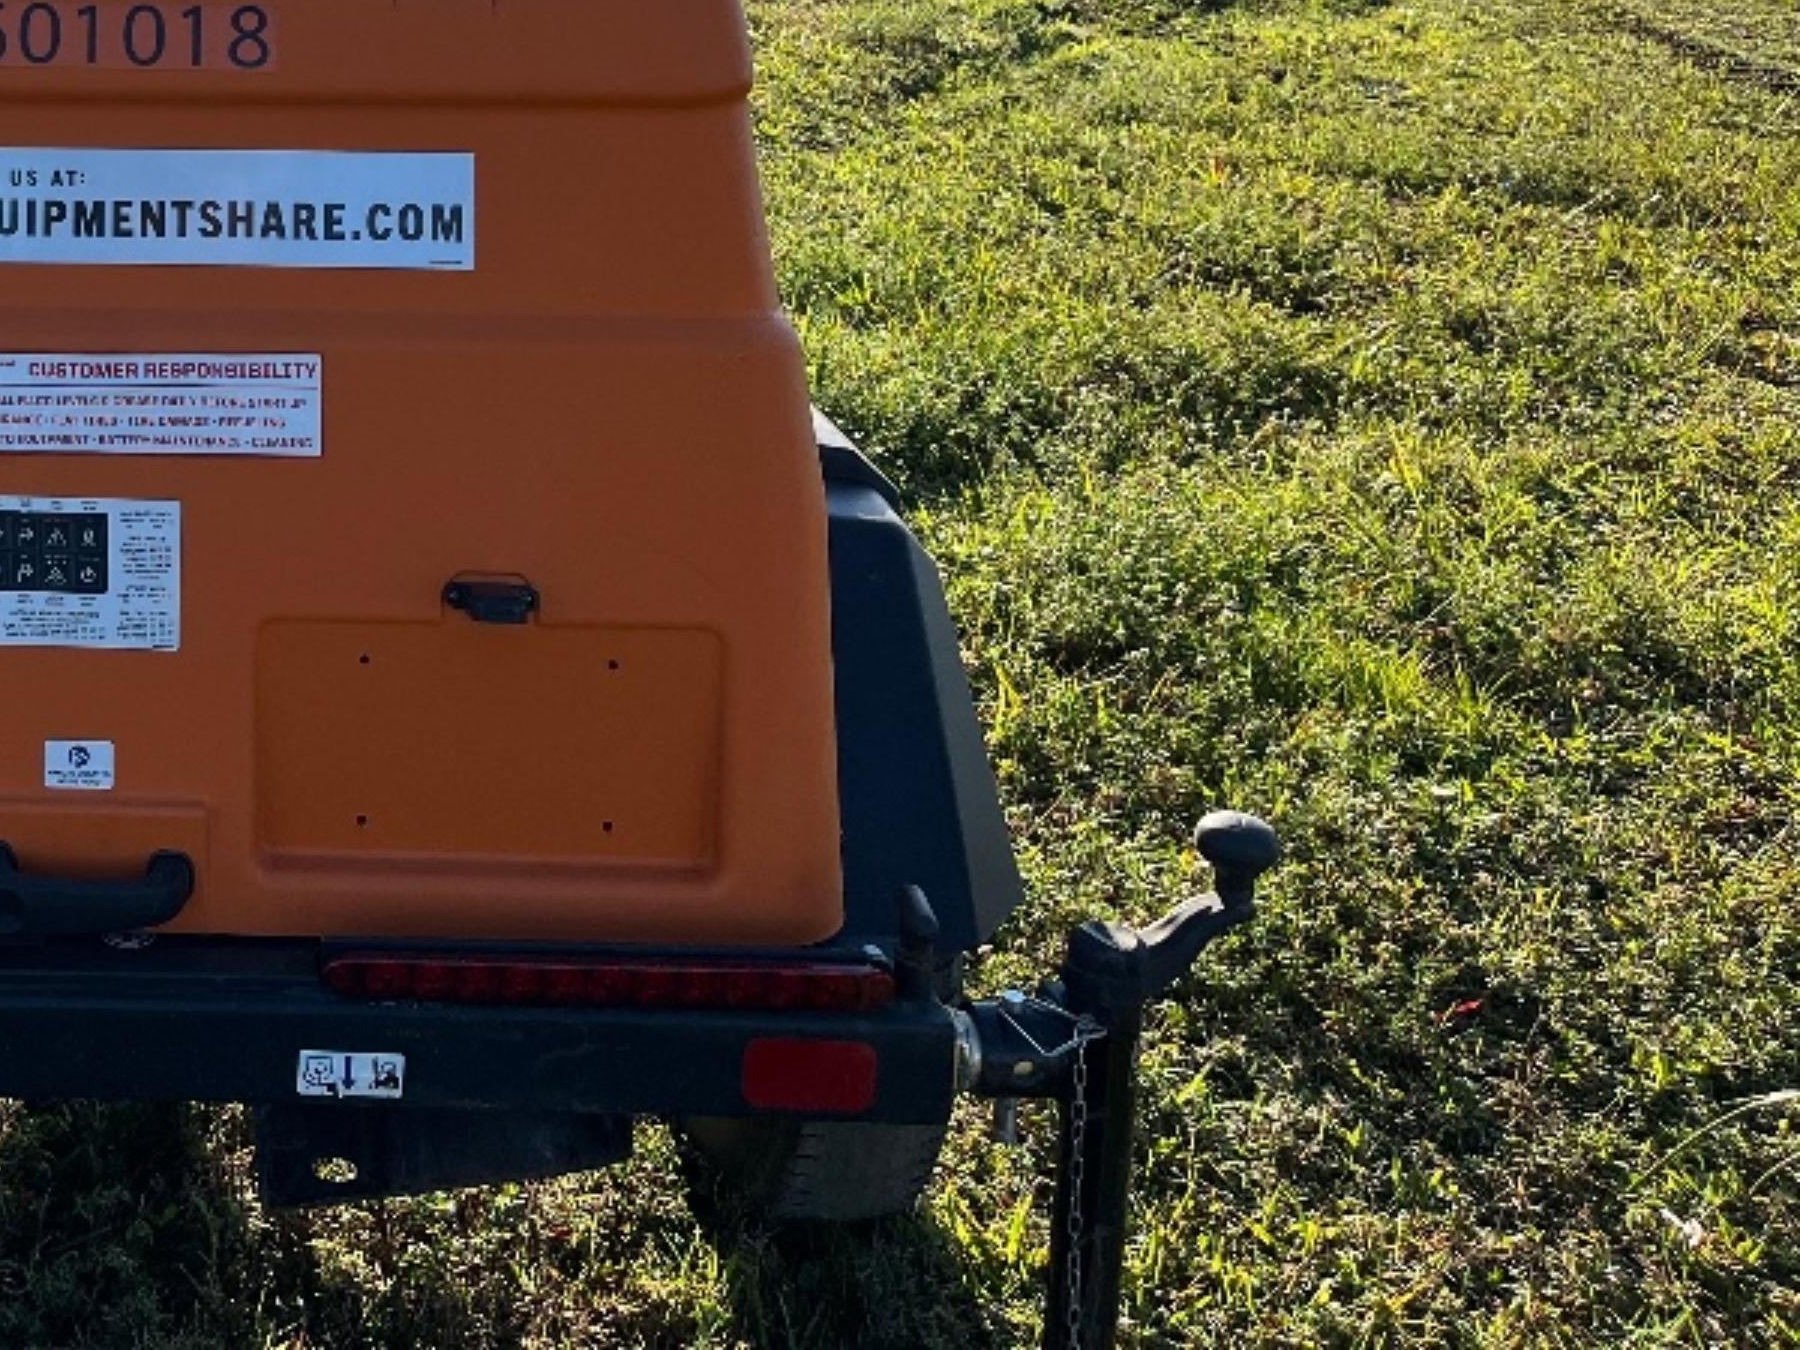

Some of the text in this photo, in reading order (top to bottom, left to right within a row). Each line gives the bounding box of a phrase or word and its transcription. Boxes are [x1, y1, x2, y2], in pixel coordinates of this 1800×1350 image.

[10, 169, 38, 187] US
[50, 169, 87, 187] AT:
[28, 361, 139, 379] CUSTOMER
[143, 362, 318, 380] RESPONSIBILITY
